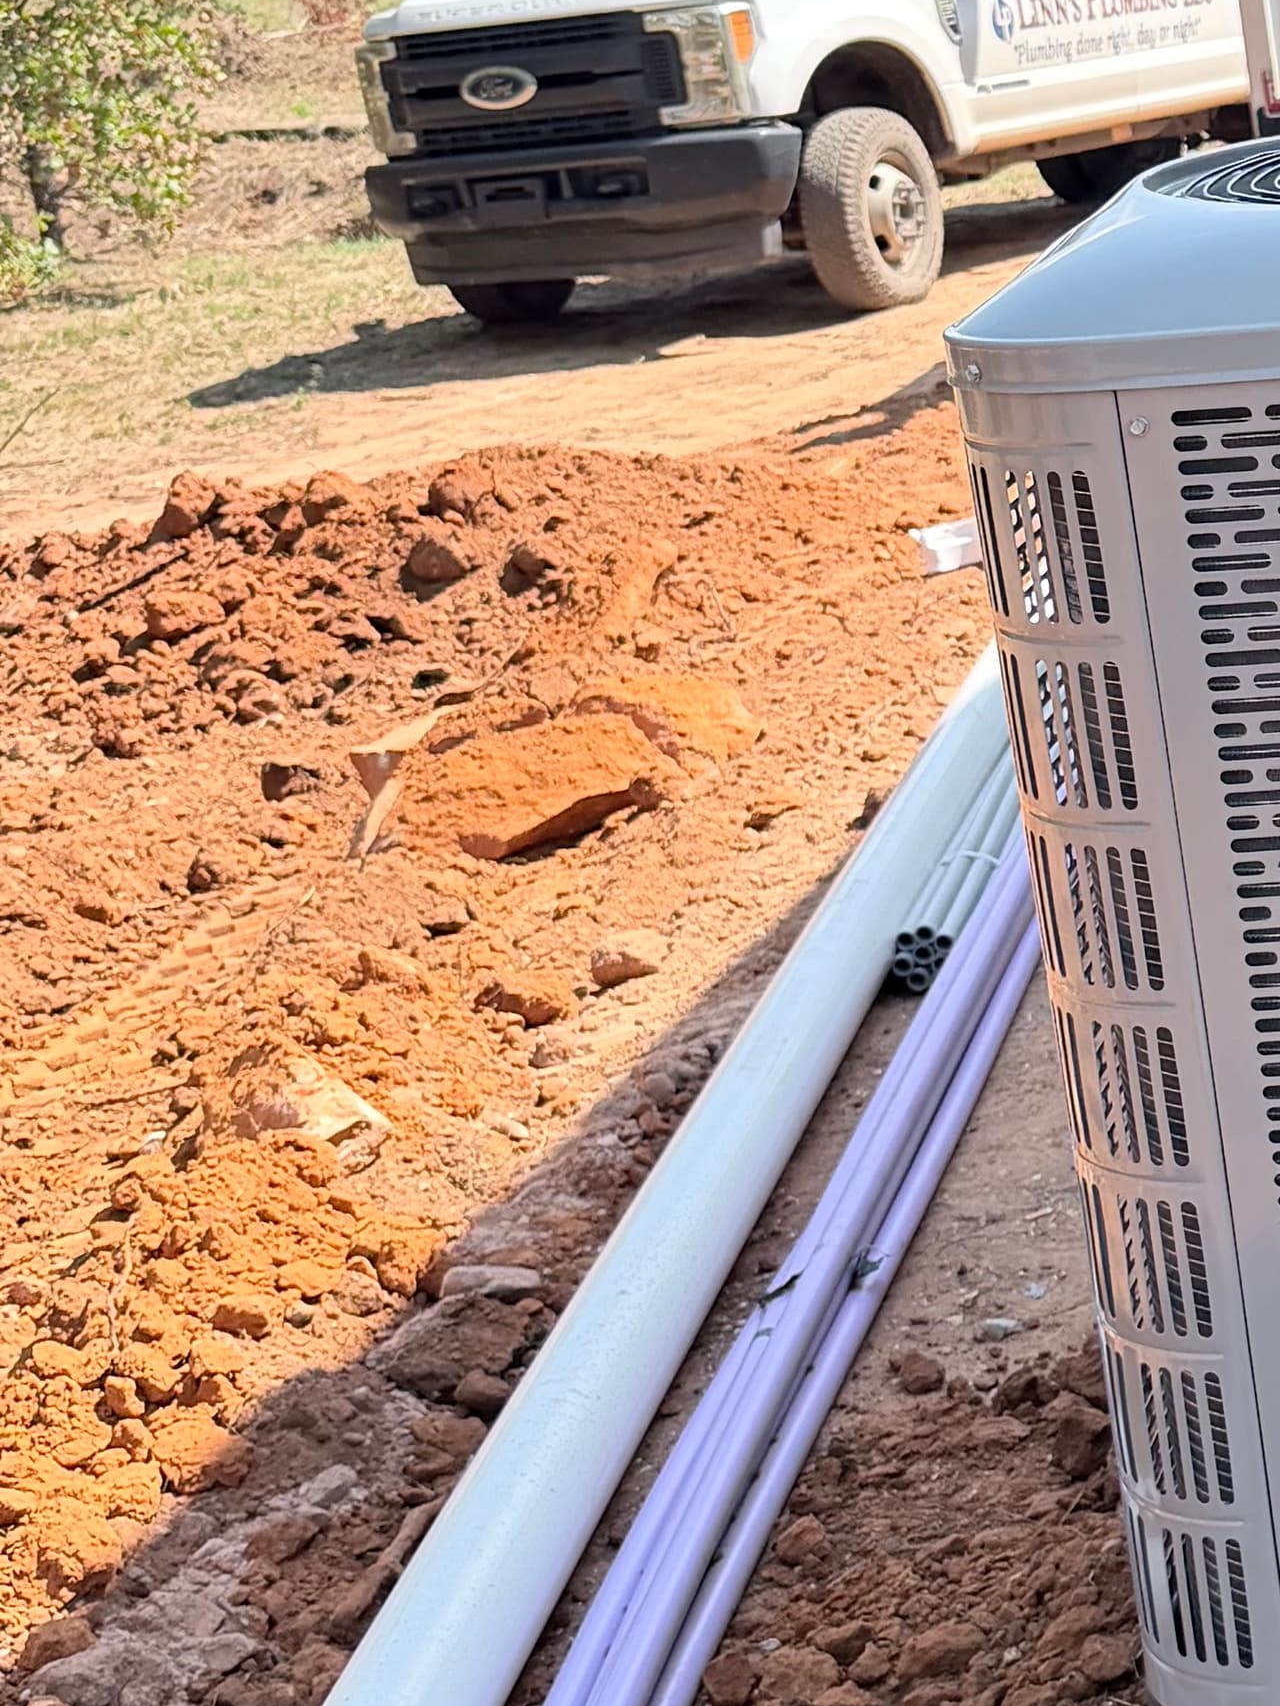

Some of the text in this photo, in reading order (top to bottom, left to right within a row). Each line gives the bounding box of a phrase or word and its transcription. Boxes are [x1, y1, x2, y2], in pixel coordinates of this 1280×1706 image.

[1077, 32, 1102, 55] done
[1138, 23, 1156, 47] day
[1159, 25, 1170, 40] or
